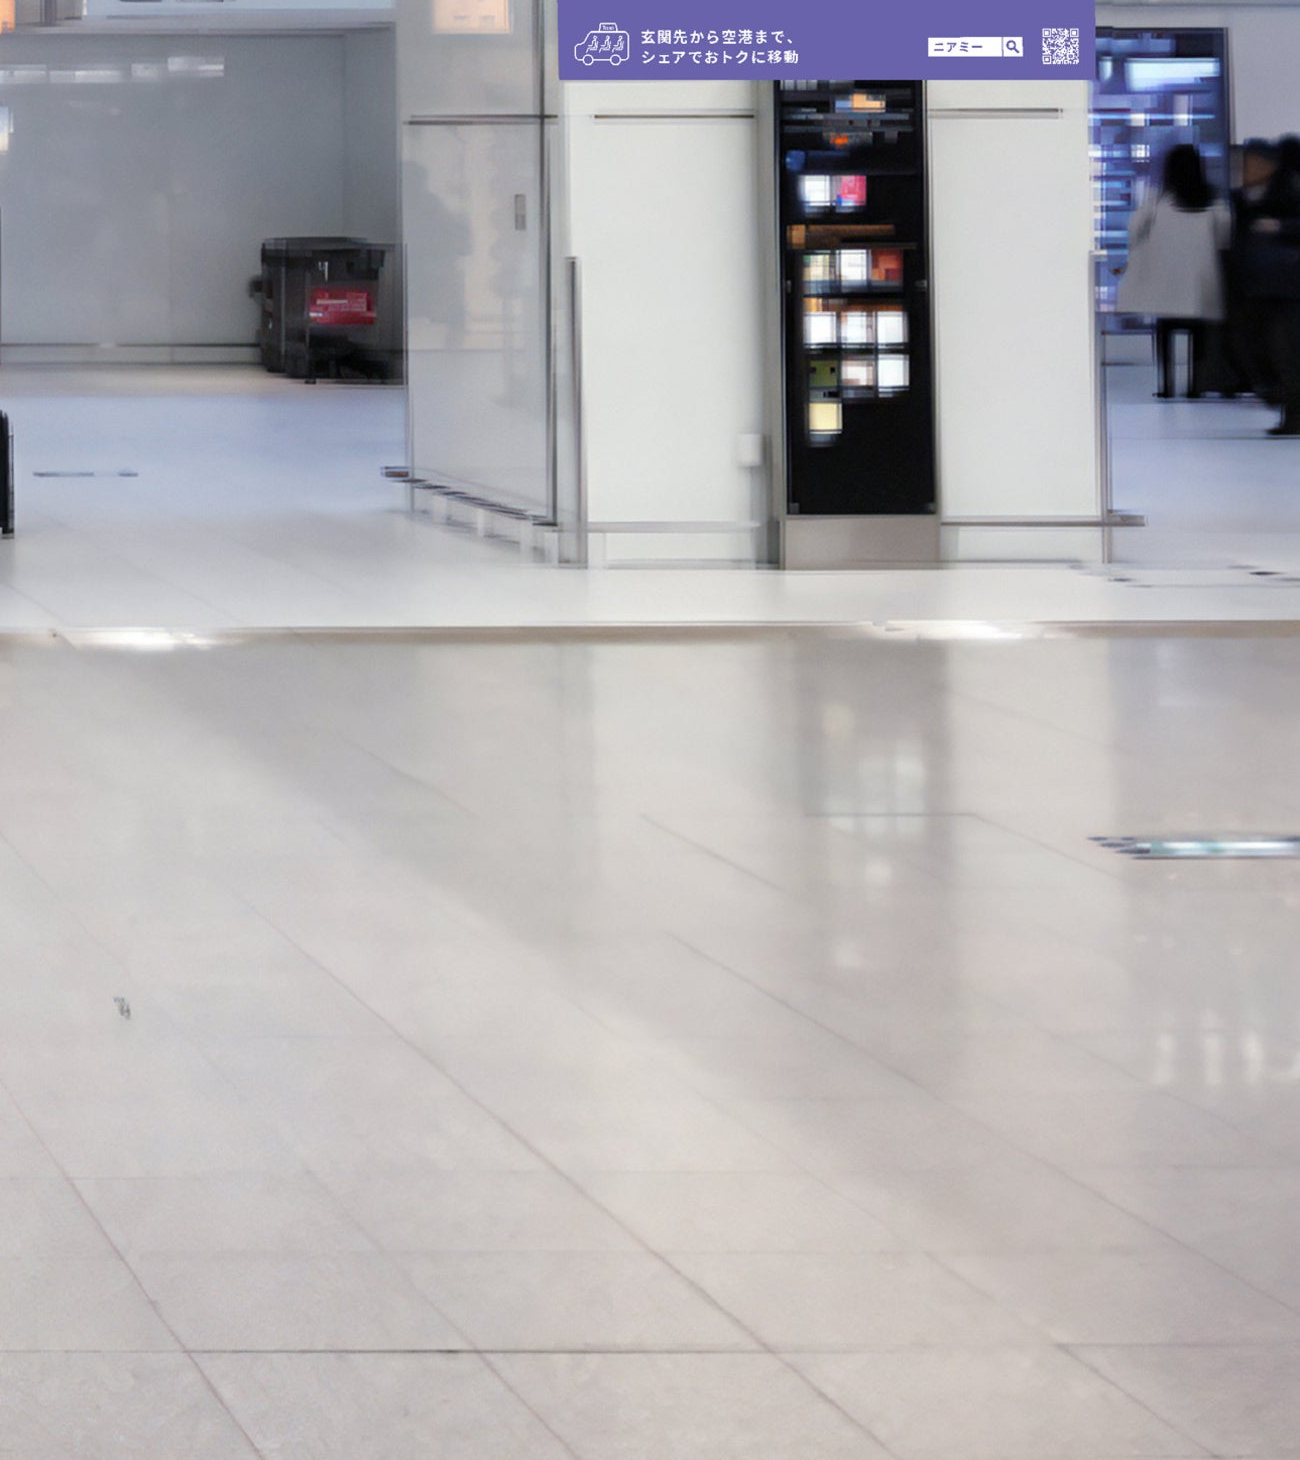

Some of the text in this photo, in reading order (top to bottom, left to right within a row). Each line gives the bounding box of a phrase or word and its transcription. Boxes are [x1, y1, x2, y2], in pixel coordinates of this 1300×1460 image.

[640, 28, 793, 45] 玄関先から空港まで、
[933, 41, 983, 53] ニアミー
[641, 49, 799, 65] シェアでおトクに移動
